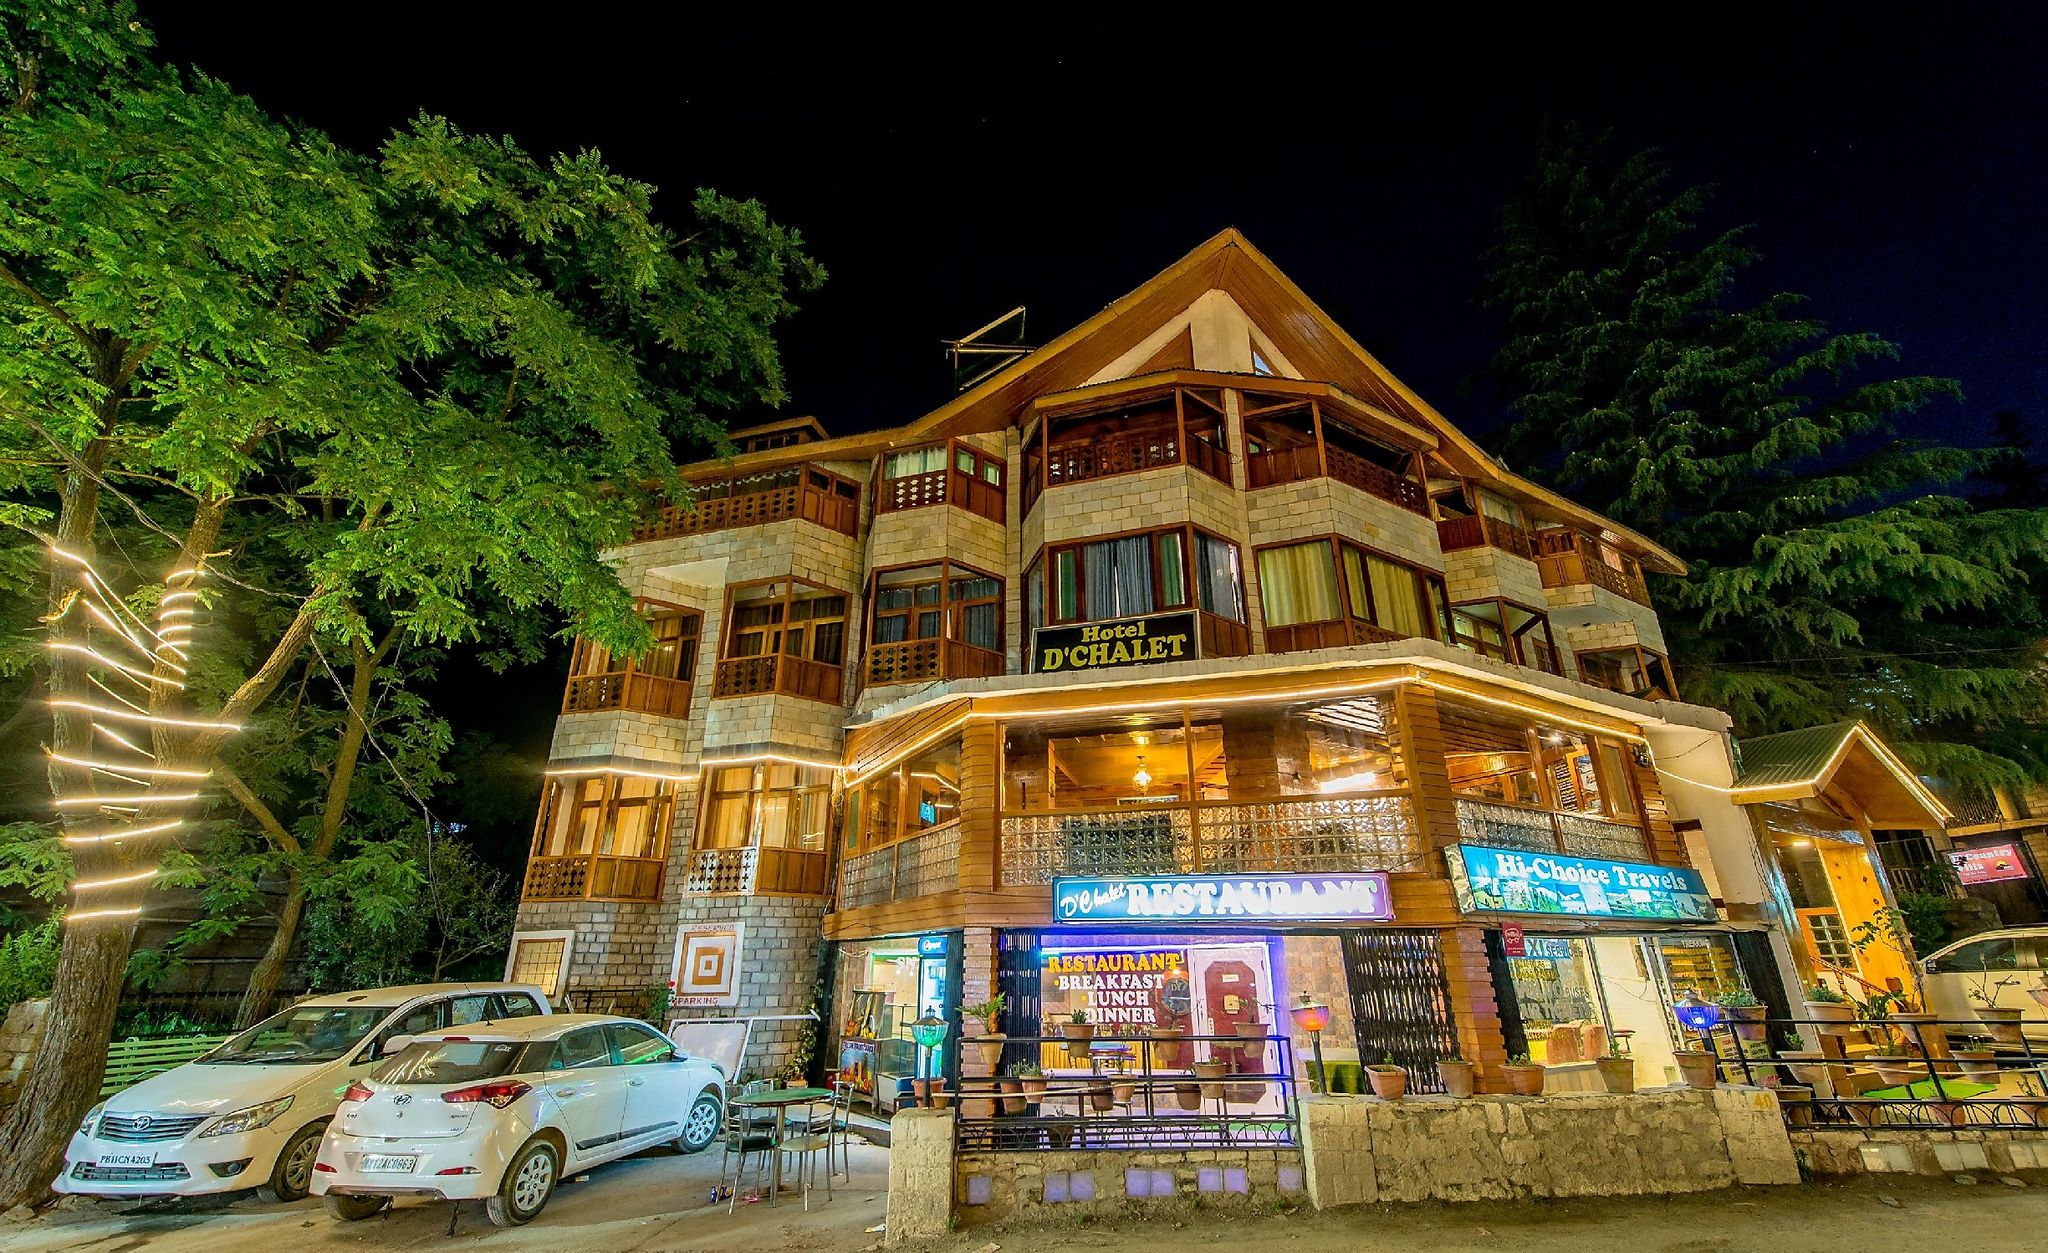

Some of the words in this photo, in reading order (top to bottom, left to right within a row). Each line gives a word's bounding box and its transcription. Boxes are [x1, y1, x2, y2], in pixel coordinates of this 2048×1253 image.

[1081, 620, 1147, 643] Hotel
[1042, 633, 1187, 670] D'CHALET
[1494, 853, 1610, 885] Hi-Choice
[1612, 865, 1688, 891] Travels
[1126, 880, 1378, 916] RESTAURANT
[1048, 953, 1182, 973] RESTAURANT
[1059, 973, 1165, 991] BREAKFAST
[677, 997, 719, 1005] PARKING
[1088, 990, 1150, 1006] LUNCH
[1085, 1007, 1156, 1024] DINNER
